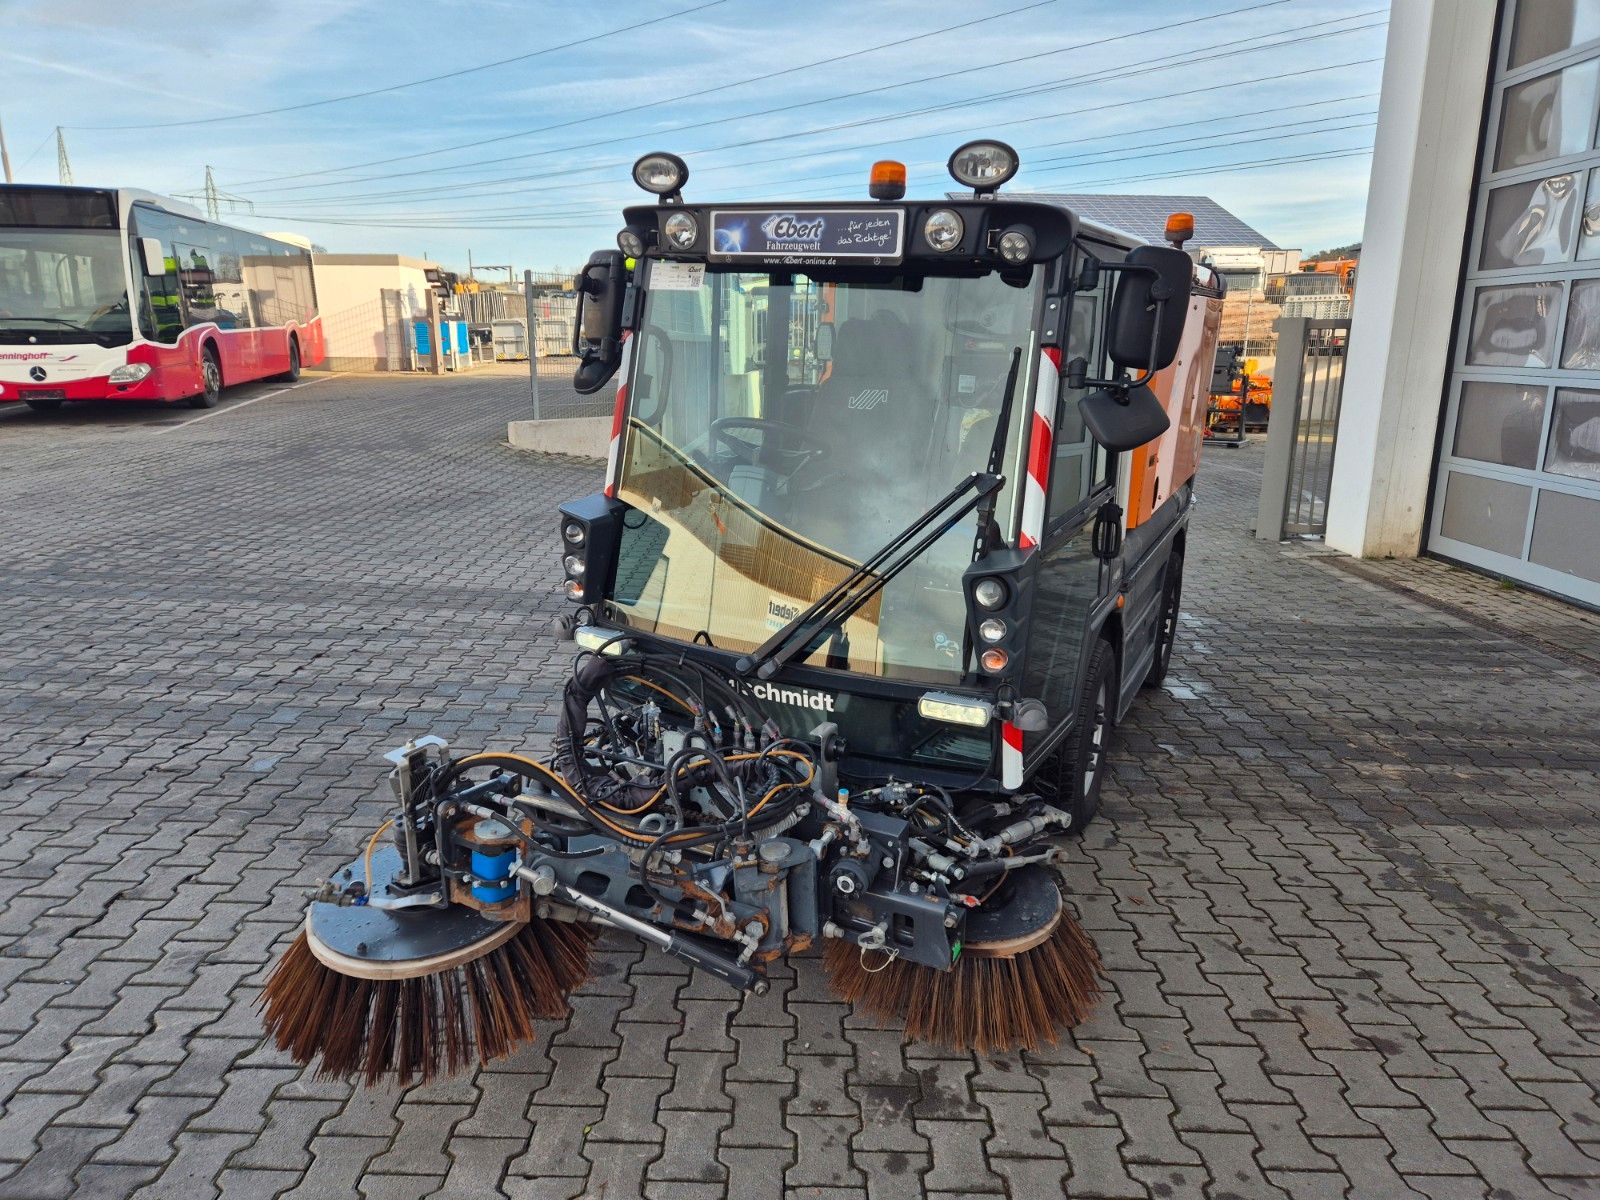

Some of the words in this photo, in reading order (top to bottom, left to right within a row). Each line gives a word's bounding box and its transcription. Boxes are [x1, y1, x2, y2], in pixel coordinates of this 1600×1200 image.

[774, 217, 823, 238] Ebert
[865, 217, 890, 231] jeden
[766, 241, 821, 252] Fahrzeugwelt
[837, 236, 853, 245] das
